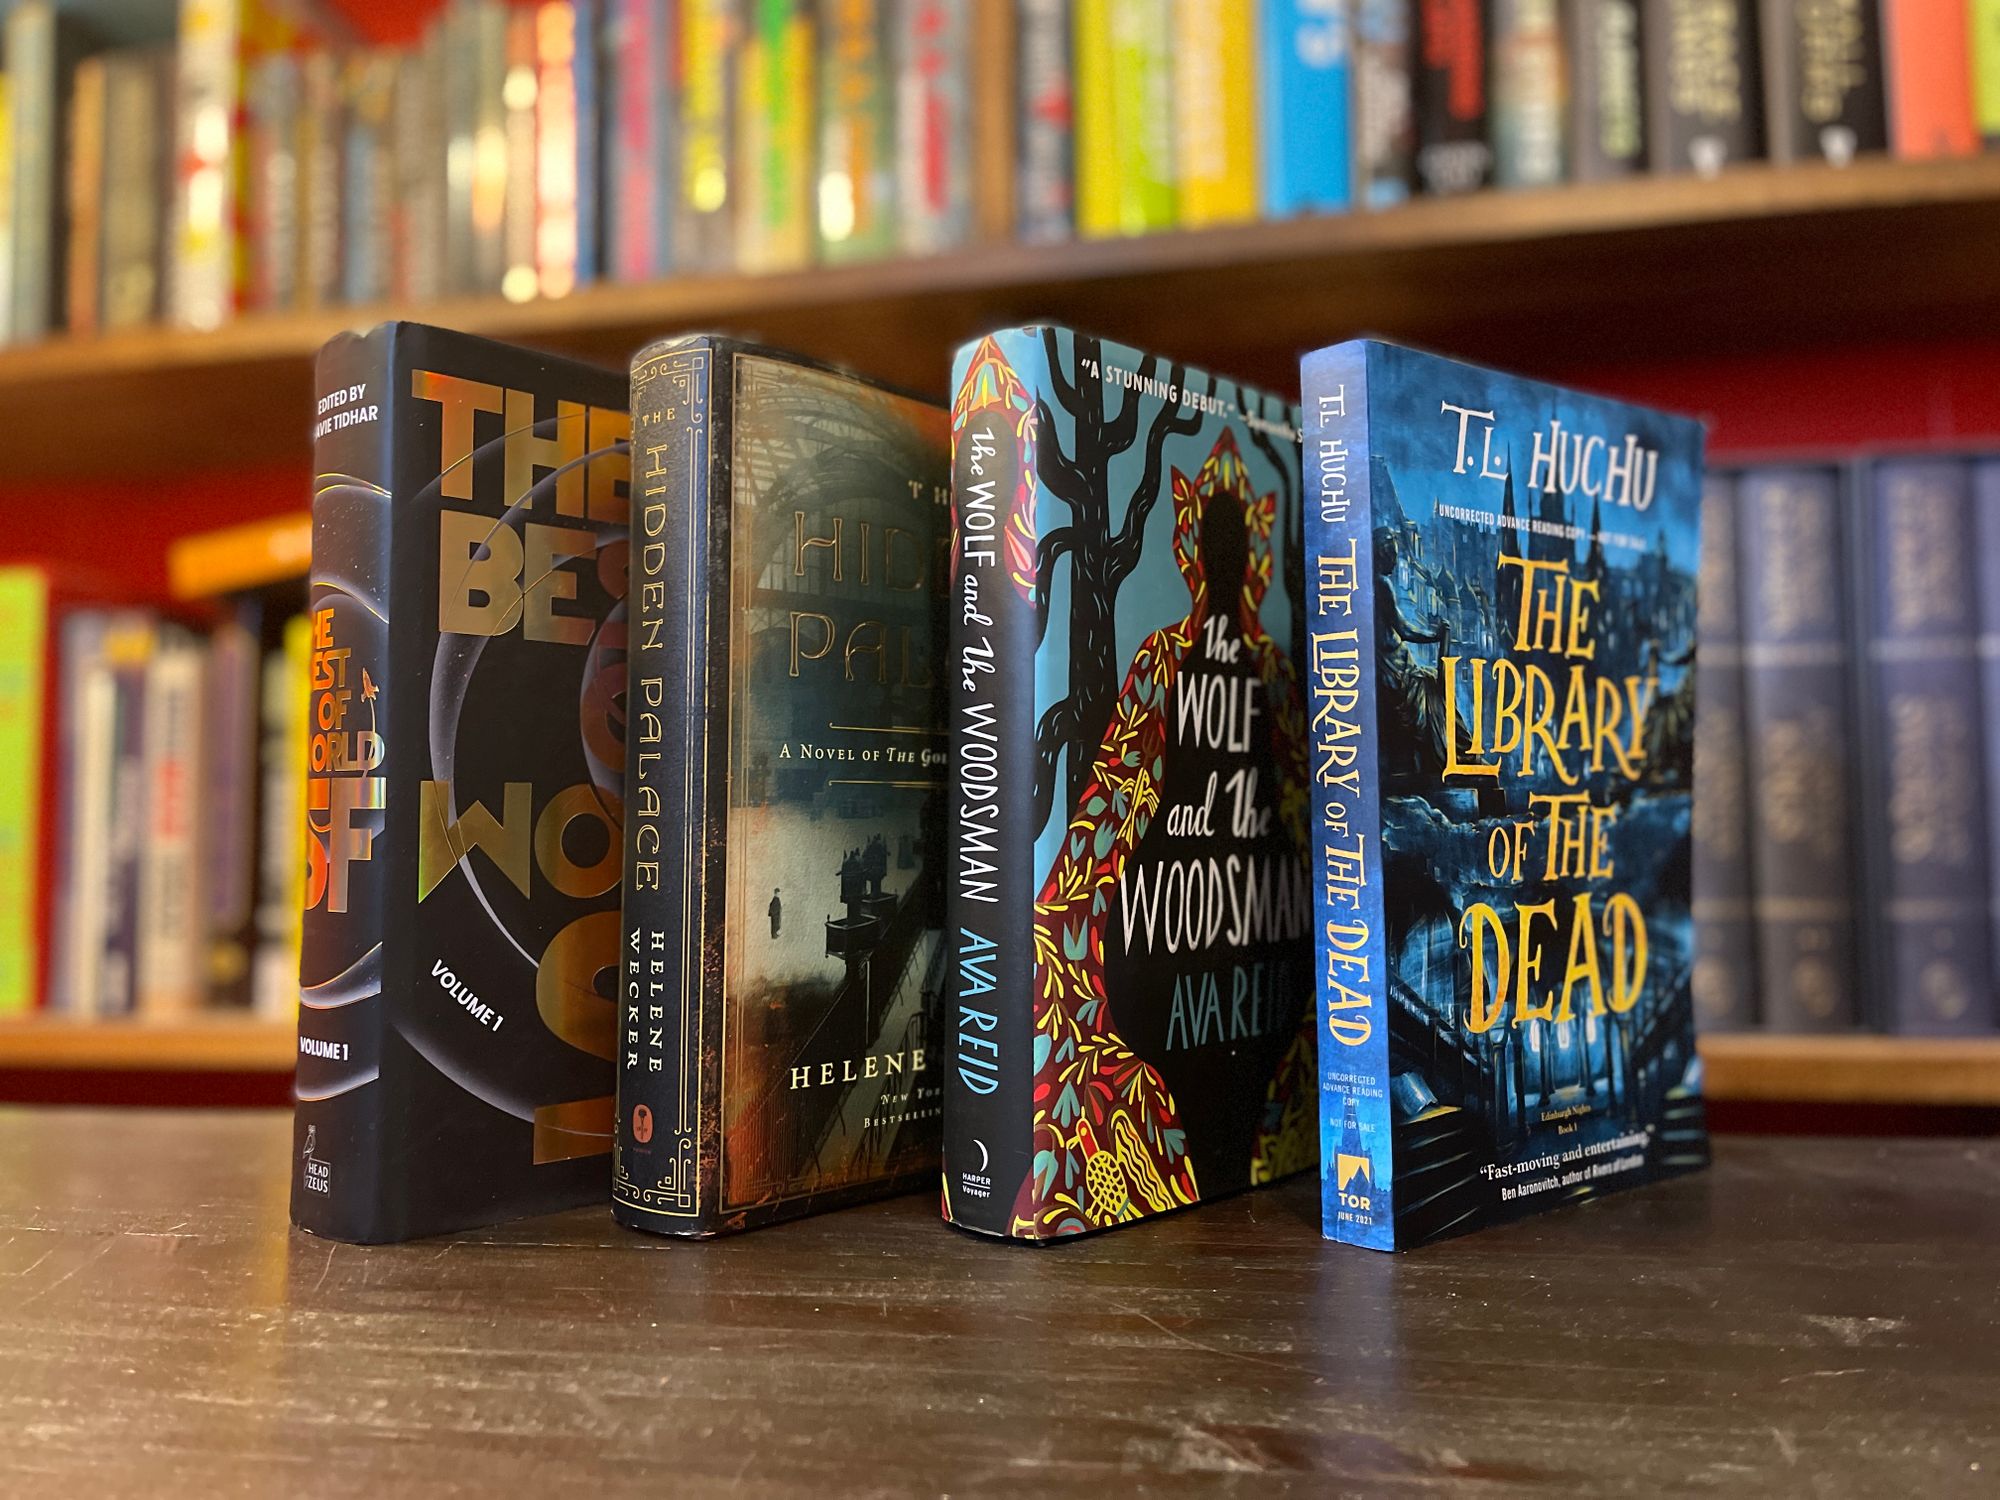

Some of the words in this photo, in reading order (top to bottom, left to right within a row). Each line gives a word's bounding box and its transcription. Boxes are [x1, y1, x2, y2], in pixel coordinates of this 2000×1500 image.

[318, 389, 347, 415] EDITED
[350, 383, 366, 402] BY
[1105, 365, 1177, 403] STUNNING
[333, 405, 378, 430] TIDHAR
[642, 408, 675, 426] THE
[1319, 439, 1350, 524] HUCHU
[1440, 400, 1508, 480] T.L.
[1527, 419, 1659, 511] HUCHU
[964, 481, 996, 567] WOLF
[1439, 504, 1494, 526] UNCORRECTED
[1497, 514, 1530, 531] ADVANCE
[641, 444, 667, 650] HIDDEN
[964, 573, 993, 627] and
[1318, 538, 1359, 616] THE
[1498, 551, 1600, 660] THE
[318, 690, 352, 731] OF
[1177, 671, 1262, 753] WOLF
[1310, 628, 1361, 798] LIBRARY
[1441, 656, 1658, 786] LIBRARY
[309, 731, 385, 772] ORLD
[779, 743, 791, 758] A
[636, 677, 663, 891] PALACE
[960, 703, 999, 903] WOODSMAN
[1167, 771, 1218, 837] and
[1324, 802, 1349, 838] OF
[1488, 820, 1535, 882] OF
[1528, 789, 1617, 881] THE
[1325, 833, 1366, 910] THE
[959, 927, 998, 997] AVA
[1327, 919, 1372, 1046] DEAD
[1459, 892, 1648, 1033] DEAD
[431, 959, 495, 1026] VOLUME
[493, 1015, 505, 1032] 1
[627, 927, 640, 1070] WECKER
[649, 931, 664, 1073] HELENE
[1166, 972, 1224, 1050] AVA
[300, 1036, 340, 1060] VOLUME
[342, 1043, 349, 1061] 1
[789, 1049, 926, 1090] HELENE
[958, 1006, 999, 1095] REID
[1323, 1082, 1350, 1095] ADVANCE
[1352, 1086, 1383, 1098] READING
[1327, 1071, 1376, 1085] UNCORRECTED
[1342, 1096, 1360, 1107] COPY
[1343, 1120, 1357, 1130] FOR
[308, 1162, 329, 1178] HEAD
[962, 1172, 991, 1185] HARPER
[1562, 1144, 1583, 1163] and
[308, 1175, 328, 1193] ZEUS
[1338, 1192, 1371, 1211] TOR
[1502, 1186, 1517, 1201] Ben
[1562, 1167, 1584, 1186] author
[1338, 1211, 1353, 1222] JUNE
[1355, 1214, 1373, 1225] 2021
